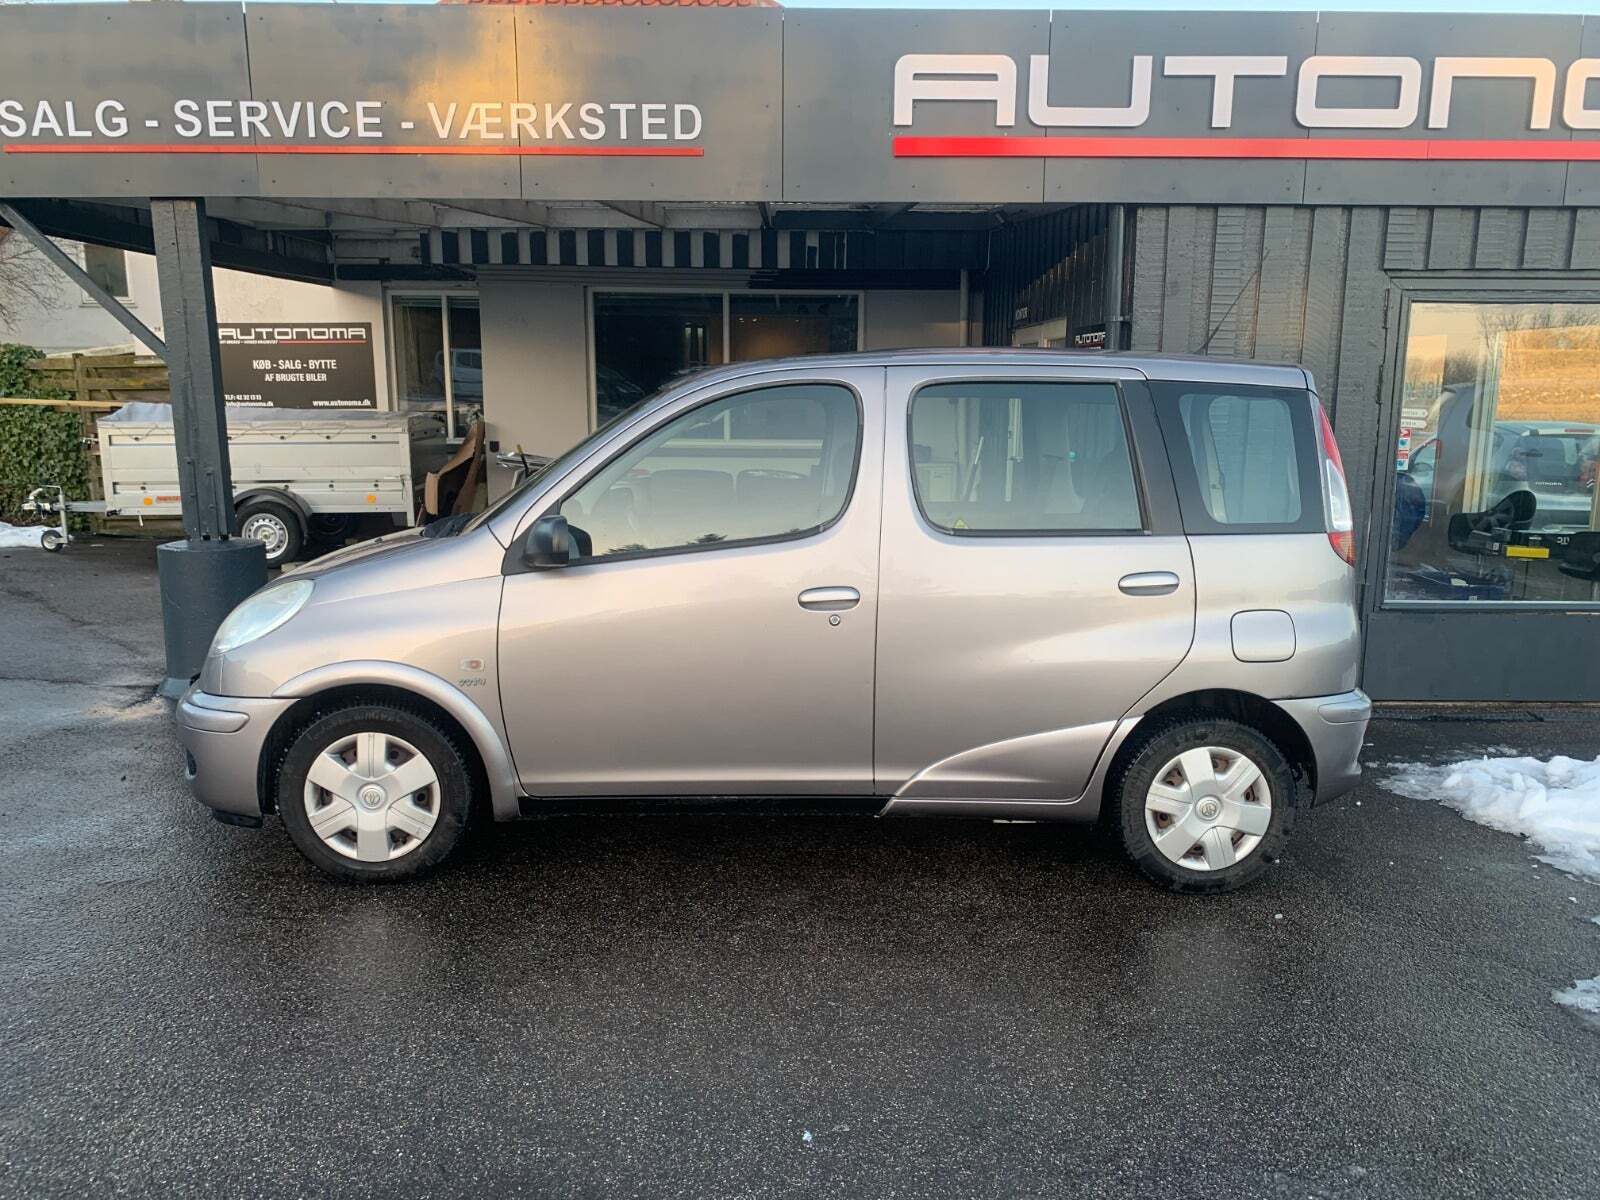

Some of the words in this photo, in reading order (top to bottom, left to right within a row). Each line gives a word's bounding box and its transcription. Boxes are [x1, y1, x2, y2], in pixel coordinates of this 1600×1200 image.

[0, 99, 129, 138] SALG
[174, 99, 384, 138] SERVICE
[427, 102, 703, 140] VÆRKSTED
[218, 327, 367, 340] AUTONOMA
[252, 359, 272, 370] KØB
[278, 359, 302, 370] SALG
[308, 359, 337, 370] BYTTE
[265, 373, 275, 382] AF
[275, 373, 305, 382] BRUGTE
[306, 373, 327, 382] BILER
